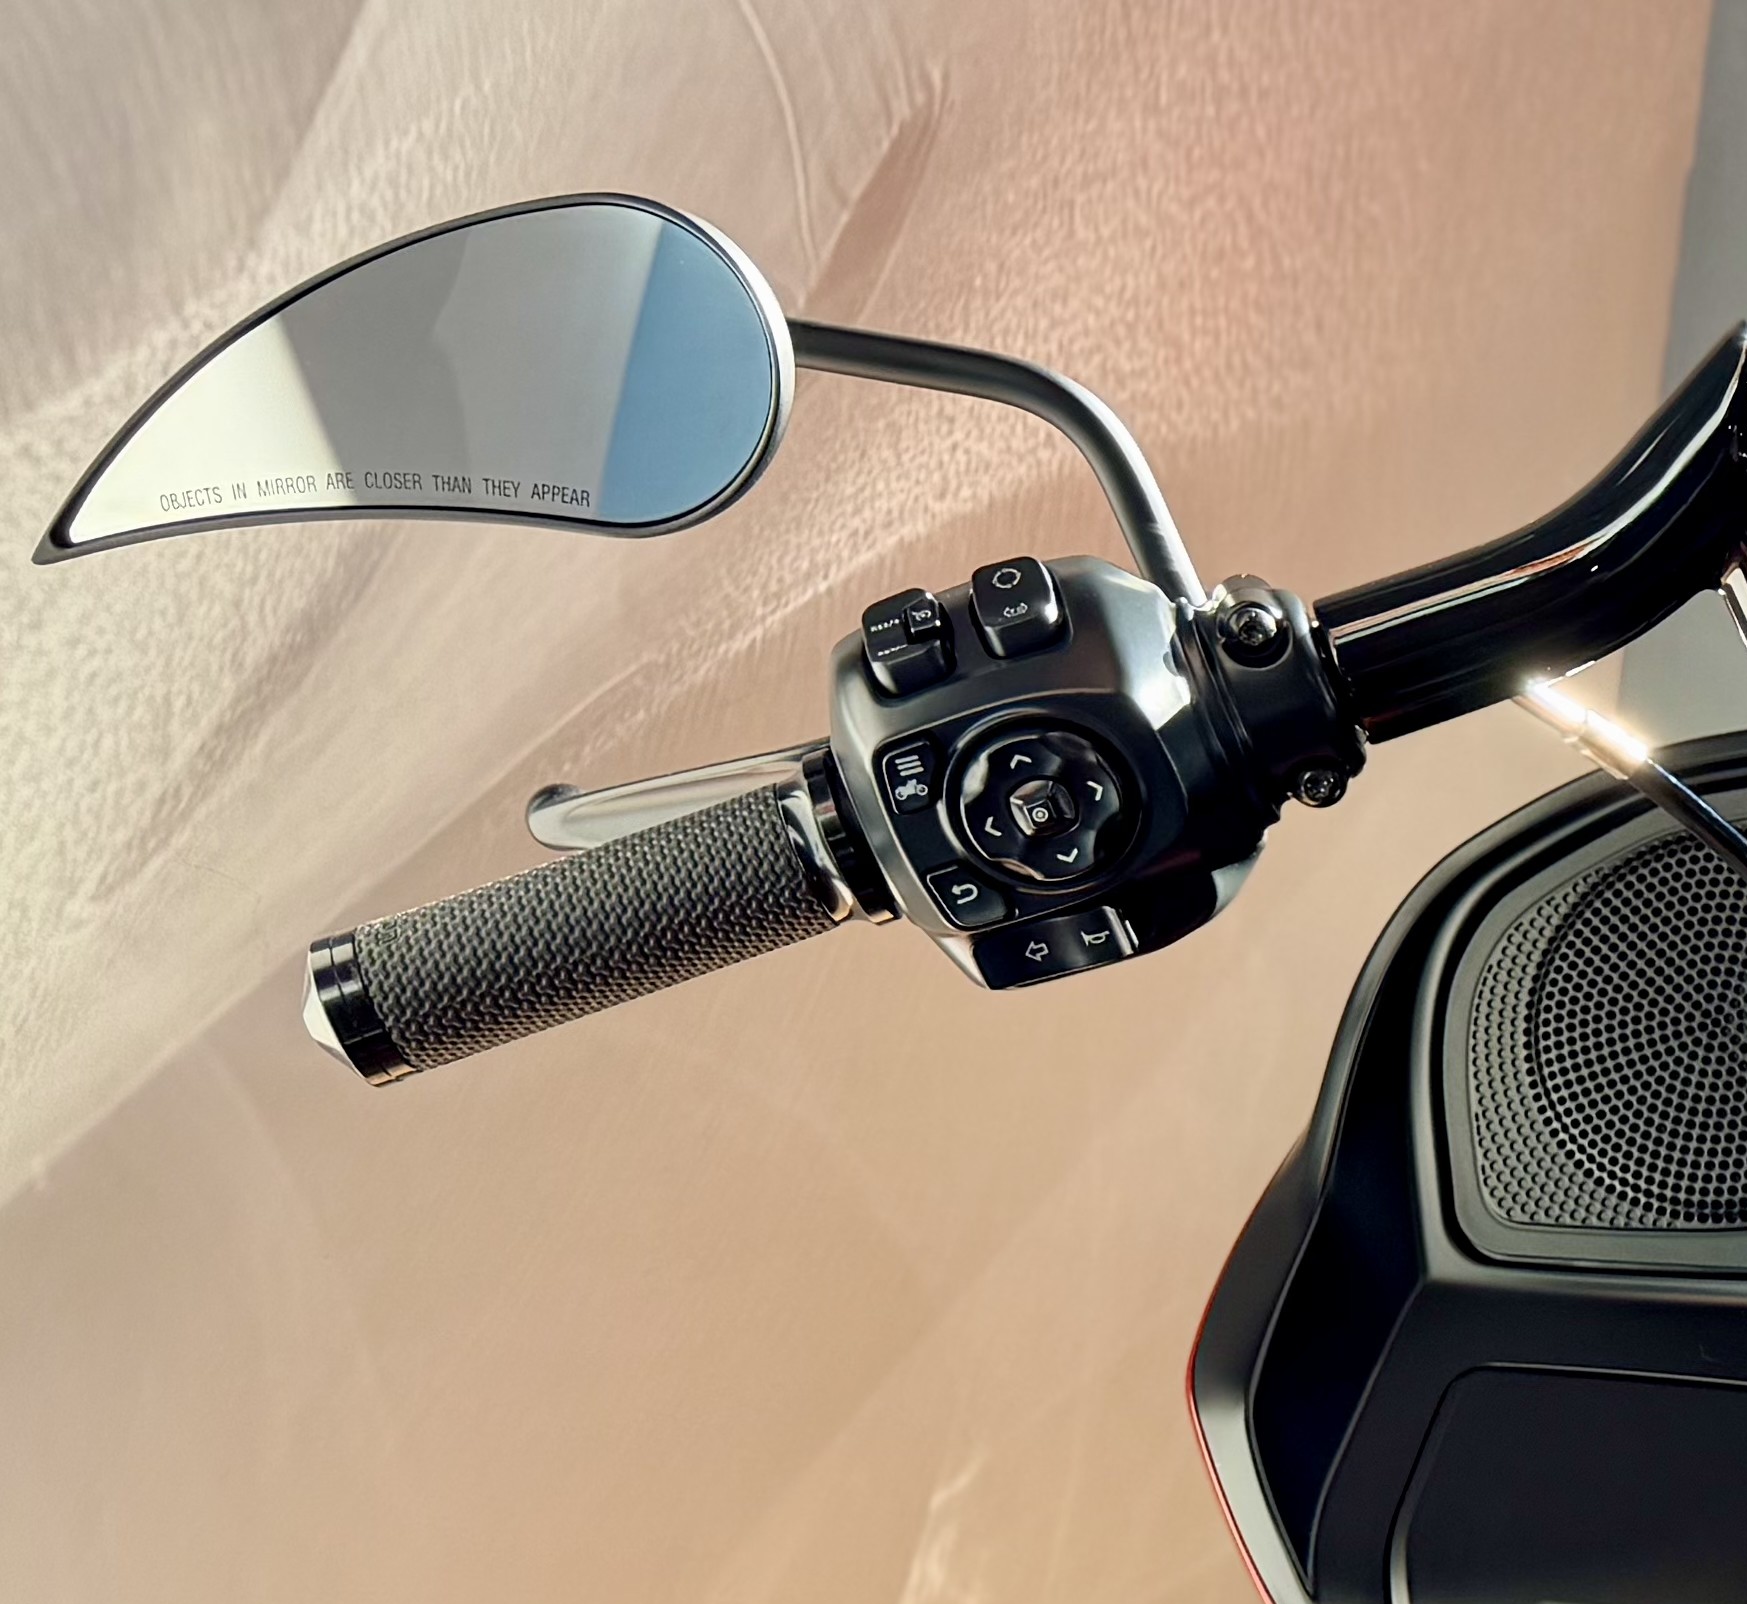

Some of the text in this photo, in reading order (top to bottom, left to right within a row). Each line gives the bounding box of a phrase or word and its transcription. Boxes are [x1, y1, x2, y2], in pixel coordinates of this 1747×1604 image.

[159, 471, 591, 513] OBJECTS IN MIRROR ARE CLOSER THAN THEY APPEAR
